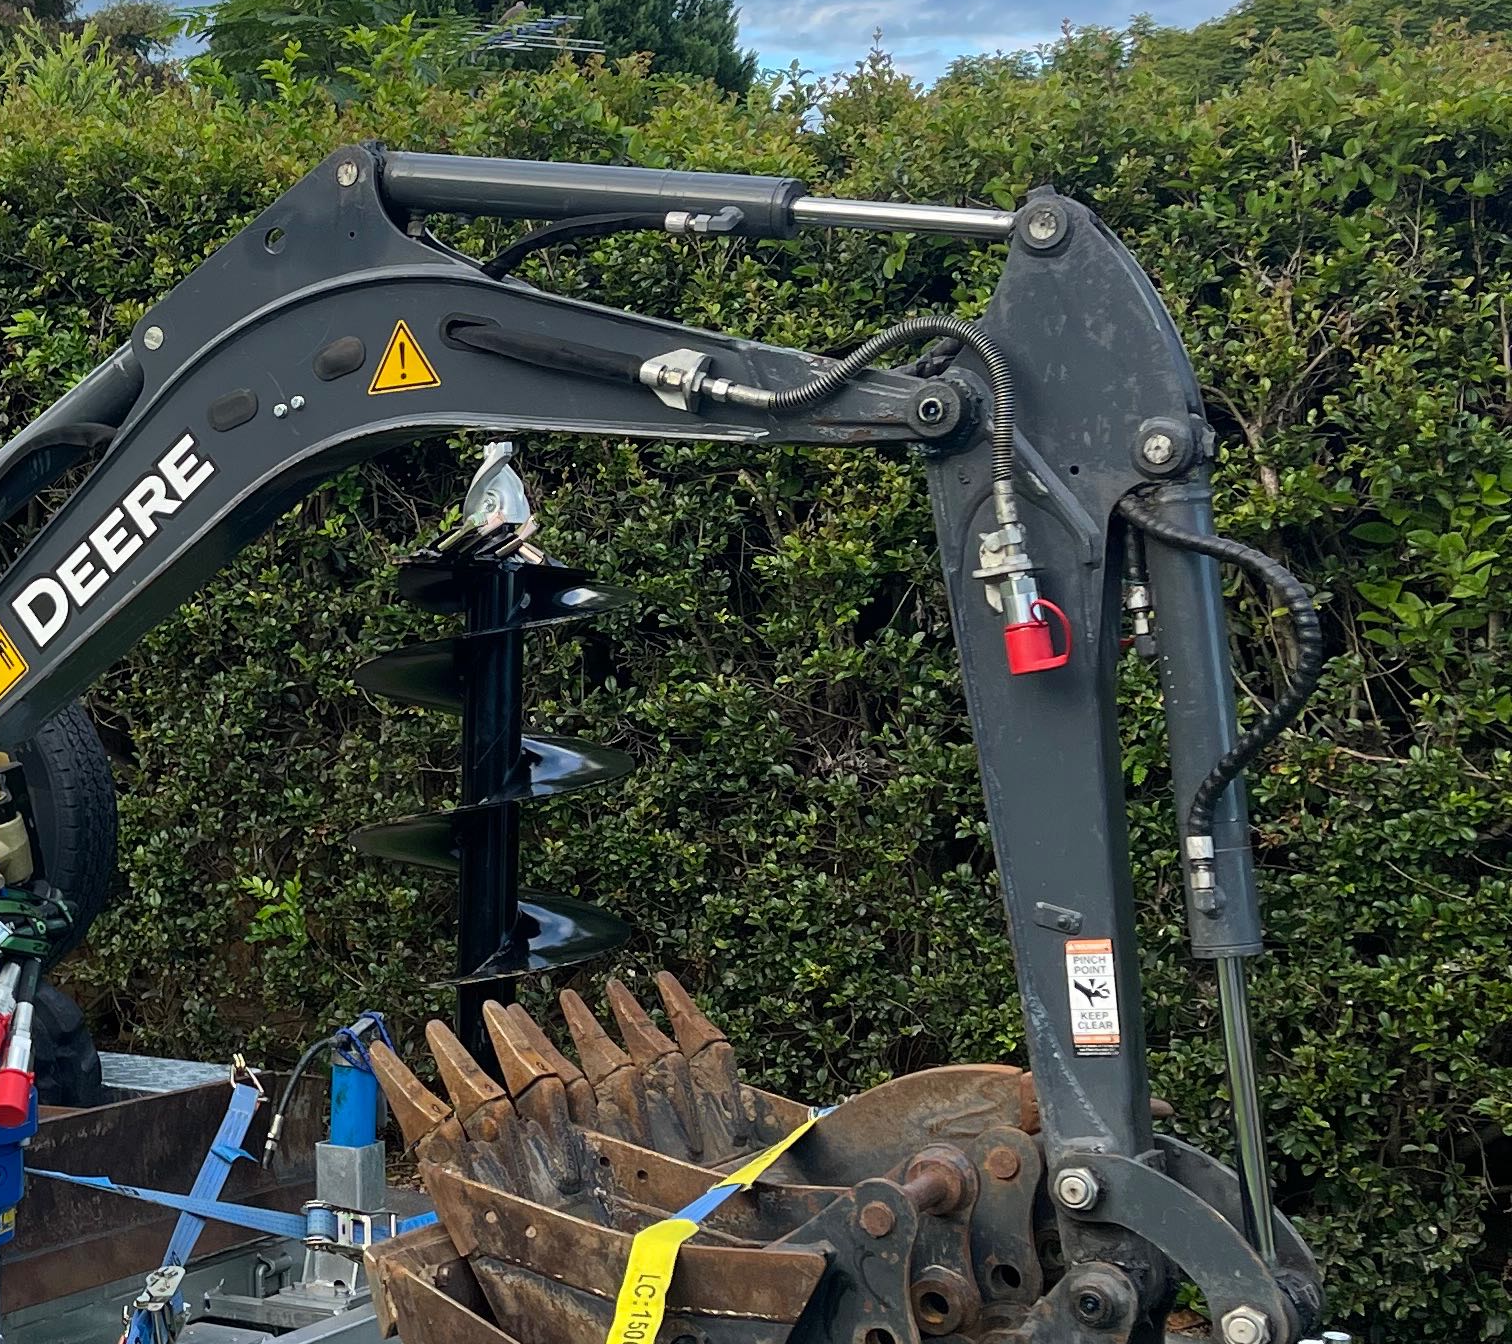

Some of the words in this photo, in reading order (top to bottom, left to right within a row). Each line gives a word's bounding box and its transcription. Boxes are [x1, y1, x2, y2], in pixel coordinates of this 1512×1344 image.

[11, 433, 216, 648] DEERE
[1072, 955, 1107, 965] PINCH
[1074, 965, 1107, 975] POINT
[1080, 1011, 1109, 1021] KEEP
[1077, 1020, 1114, 1030] CLEAR
